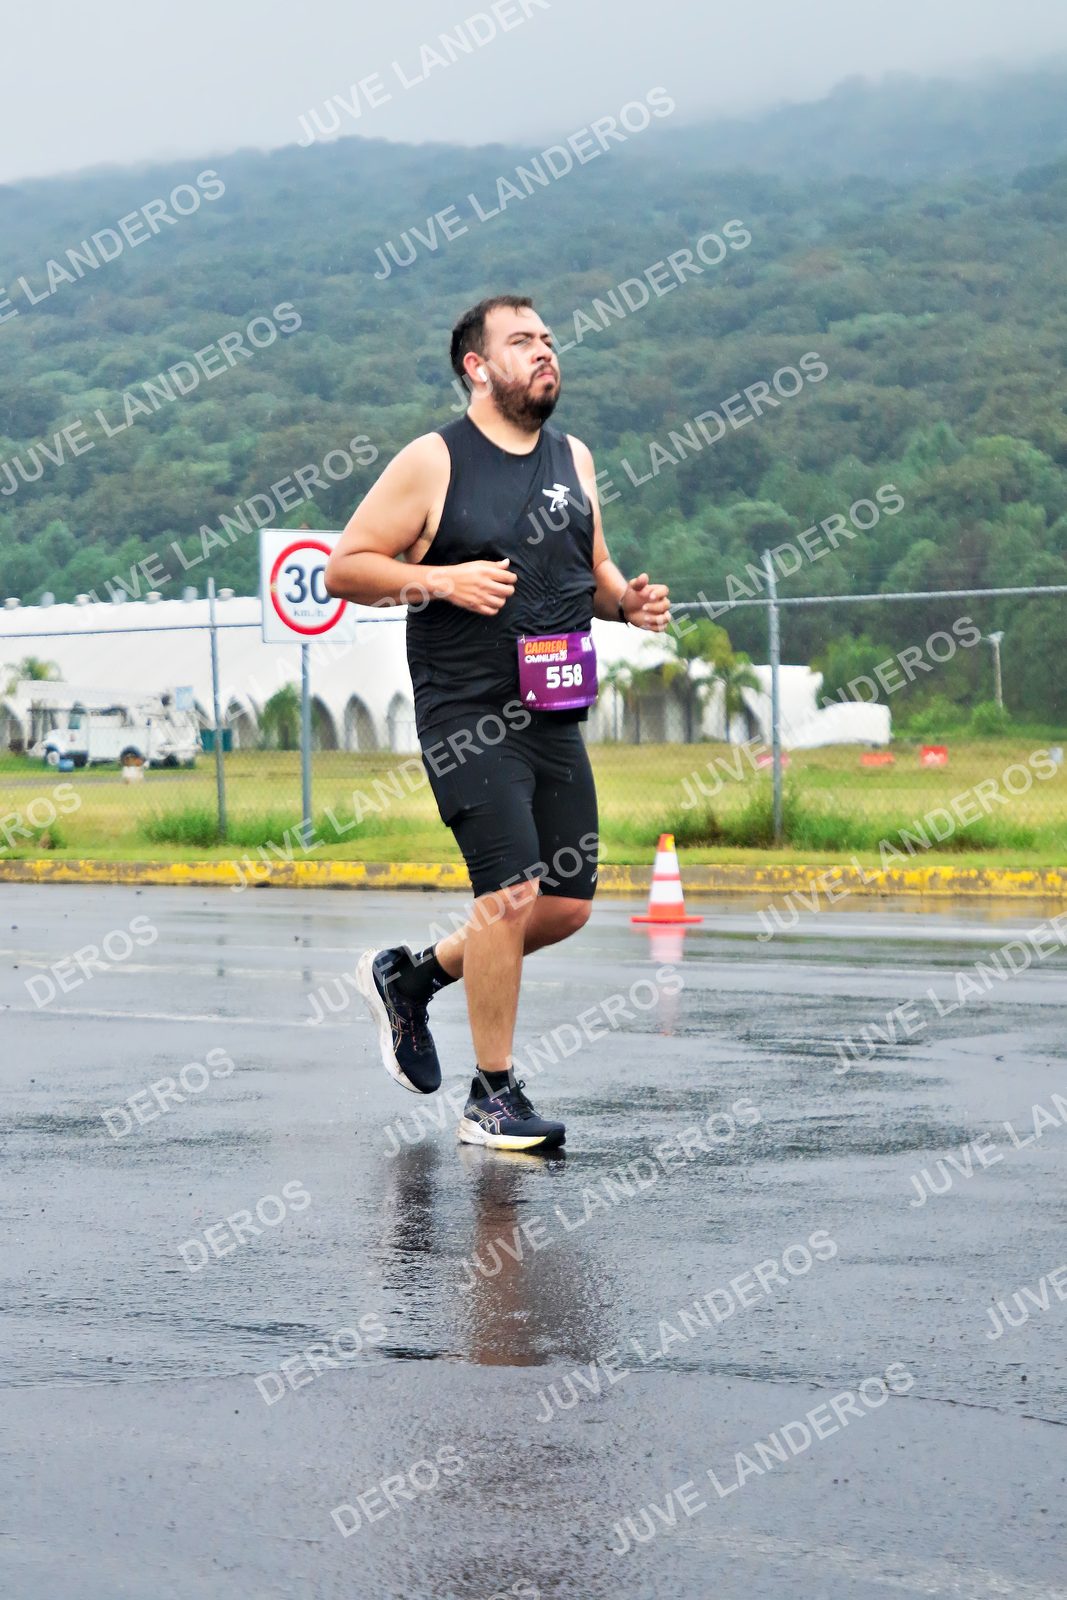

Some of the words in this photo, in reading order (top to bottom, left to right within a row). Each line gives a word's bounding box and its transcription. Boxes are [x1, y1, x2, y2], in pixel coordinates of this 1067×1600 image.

[285, 564, 331, 604] 30
[525, 640, 567, 655] CARRERA
[546, 664, 583, 688] 558
